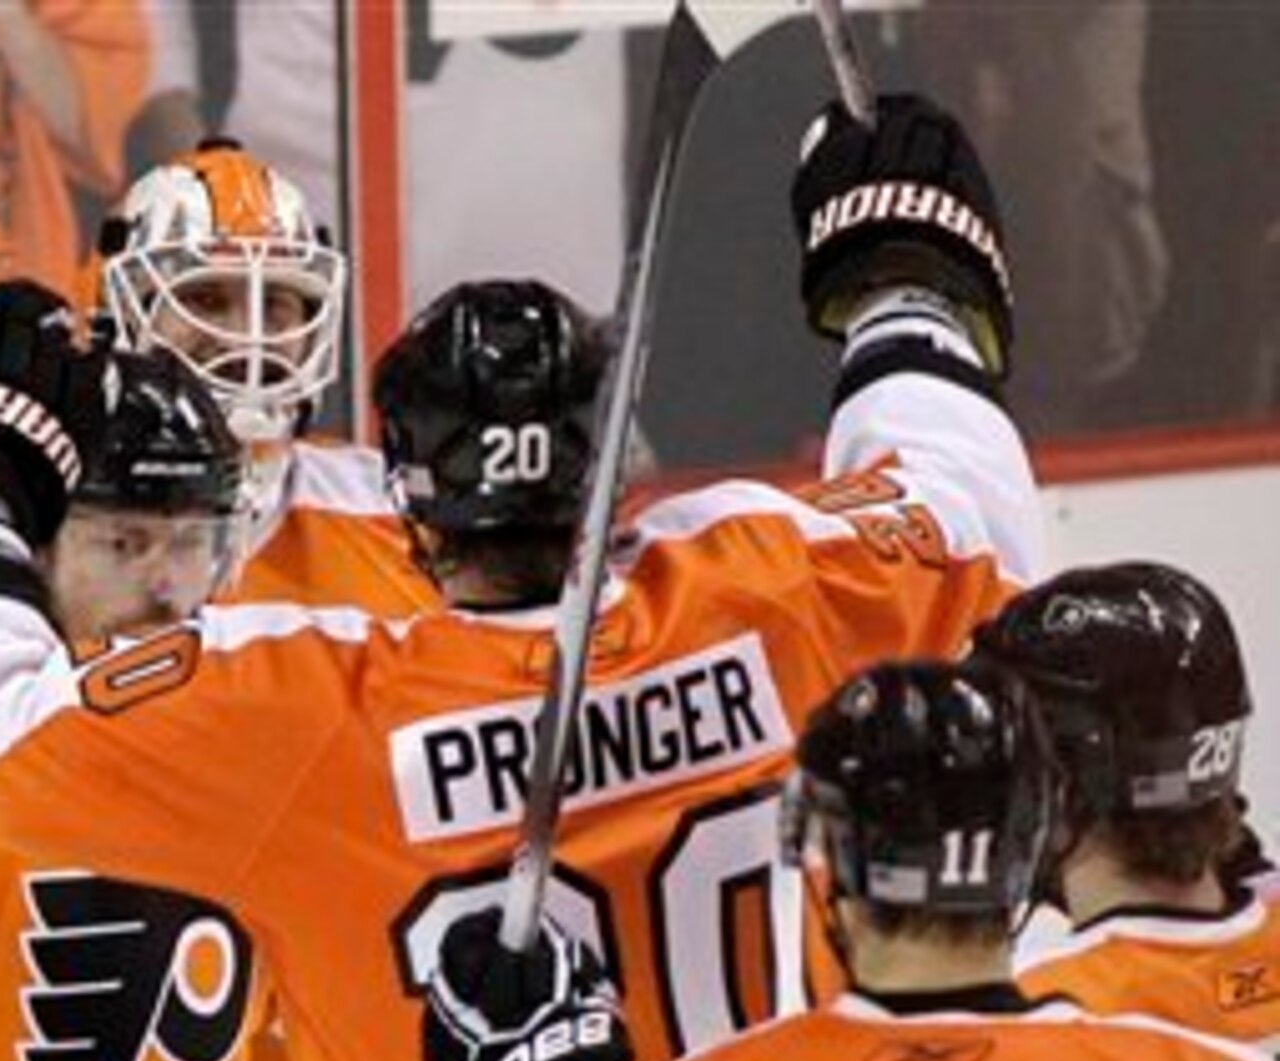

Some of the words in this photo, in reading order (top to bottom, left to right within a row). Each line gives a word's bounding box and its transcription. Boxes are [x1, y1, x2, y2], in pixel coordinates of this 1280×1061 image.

[482, 425, 551, 481] 20
[1188, 721, 1242, 781] 28
[938, 831, 990, 885] 11
